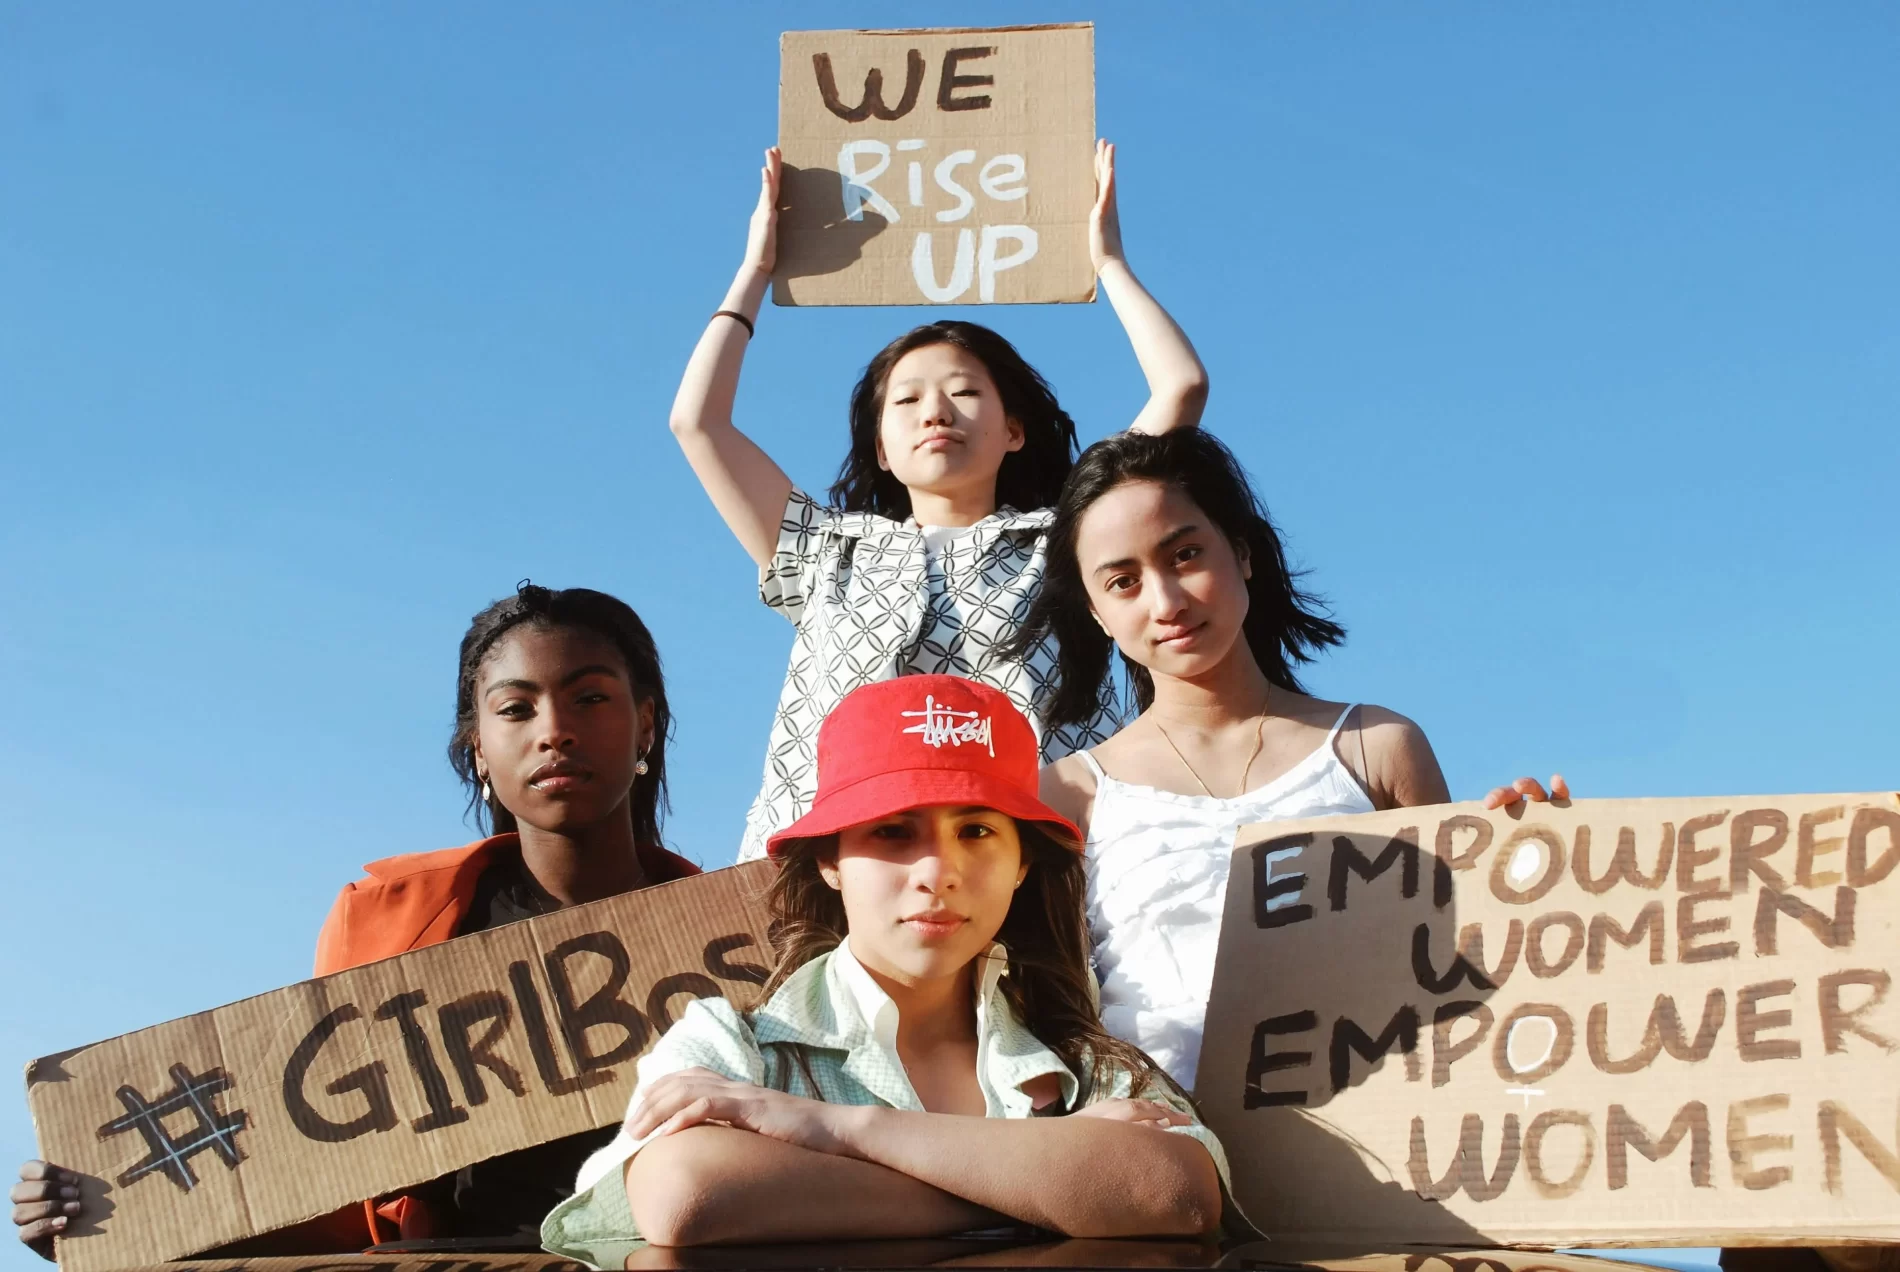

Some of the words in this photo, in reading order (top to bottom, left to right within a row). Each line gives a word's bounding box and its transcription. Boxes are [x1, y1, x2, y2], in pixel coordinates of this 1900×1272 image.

[812, 46, 998, 123] WE
[837, 139, 1029, 223] Rise
[912, 225, 1038, 303] UP
[1252, 807, 1900, 928] EMPOWERED
[1411, 885, 1856, 994] WOMEN
[1243, 968, 1900, 1109] EMPOWER
[1405, 1093, 1900, 1202] WOMEN
